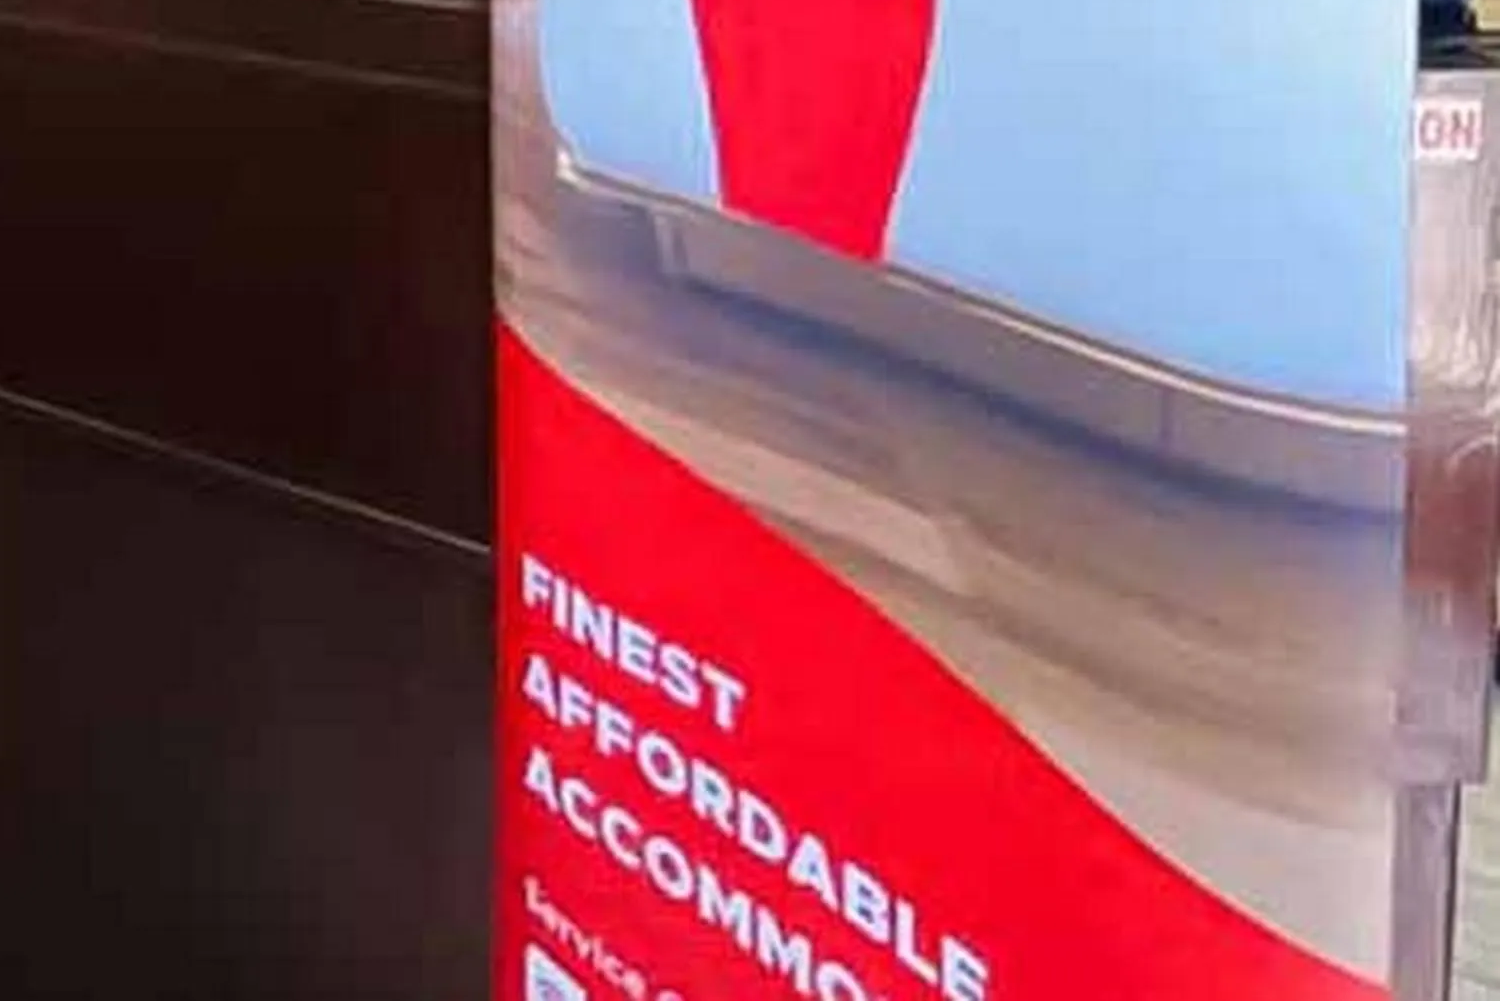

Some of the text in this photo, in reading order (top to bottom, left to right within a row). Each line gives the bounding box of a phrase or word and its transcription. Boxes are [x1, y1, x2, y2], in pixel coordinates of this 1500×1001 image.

[522, 553, 746, 731] FINEST
[522, 654, 988, 1000] AFFORDABLE
[523, 746, 887, 1000] ACCOMMO
